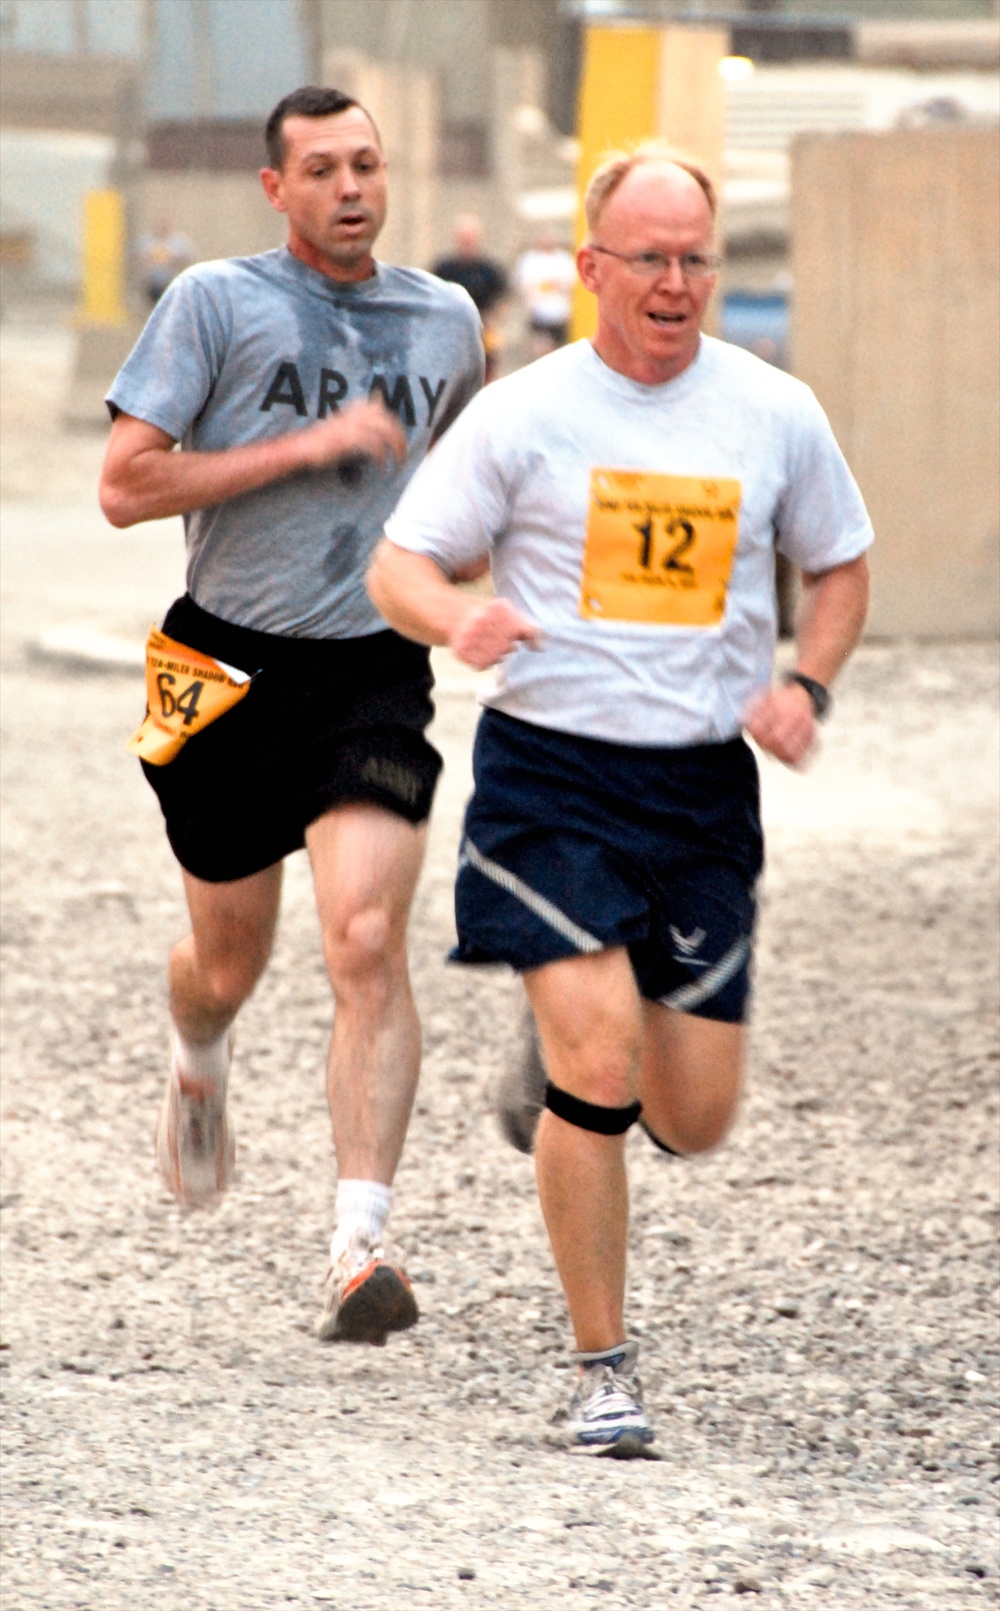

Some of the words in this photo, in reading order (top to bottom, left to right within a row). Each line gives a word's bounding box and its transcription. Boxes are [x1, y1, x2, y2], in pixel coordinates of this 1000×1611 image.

[258, 361, 447, 428] ARMY
[632, 517, 695, 574] 12
[157, 671, 205, 727] 64
